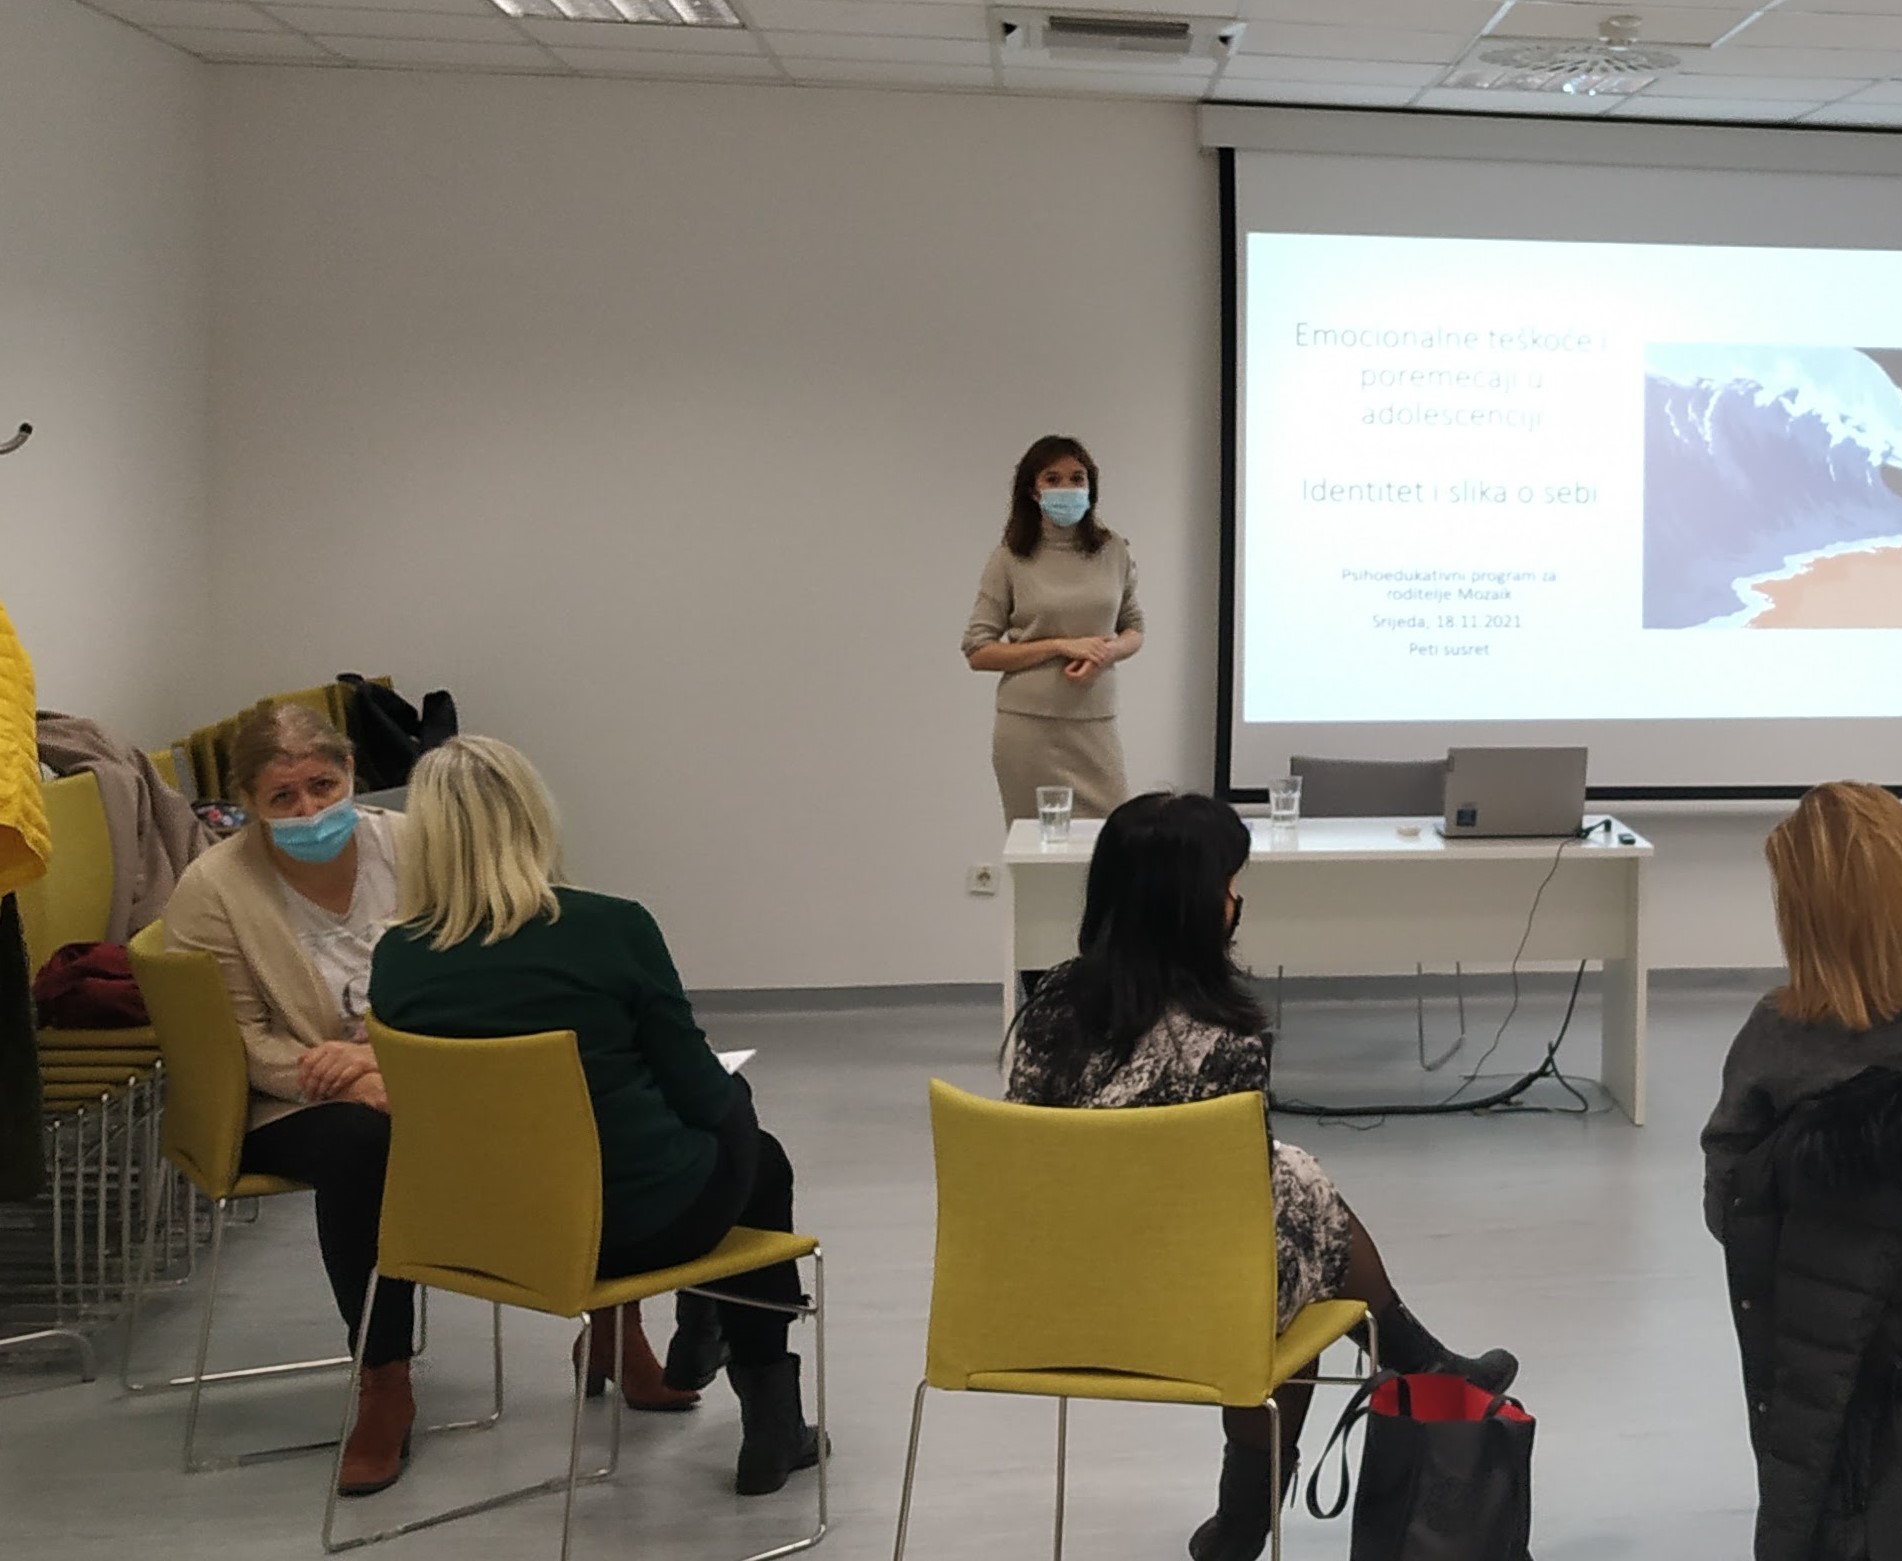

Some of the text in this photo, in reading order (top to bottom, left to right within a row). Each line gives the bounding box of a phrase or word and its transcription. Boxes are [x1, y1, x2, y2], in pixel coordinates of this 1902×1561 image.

[1296, 322, 1479, 350] Emocionalne
[1361, 401, 1543, 431] adolescenciji
[1302, 479, 1598, 505] Identitet i slika o sebi
[1341, 568, 1557, 585] Psihoedukativni program za
[1387, 588, 1512, 603] roditelje Mozaik
[1372, 614, 1431, 631] Srijeda,
[1409, 642, 1491, 656] Peti susret
